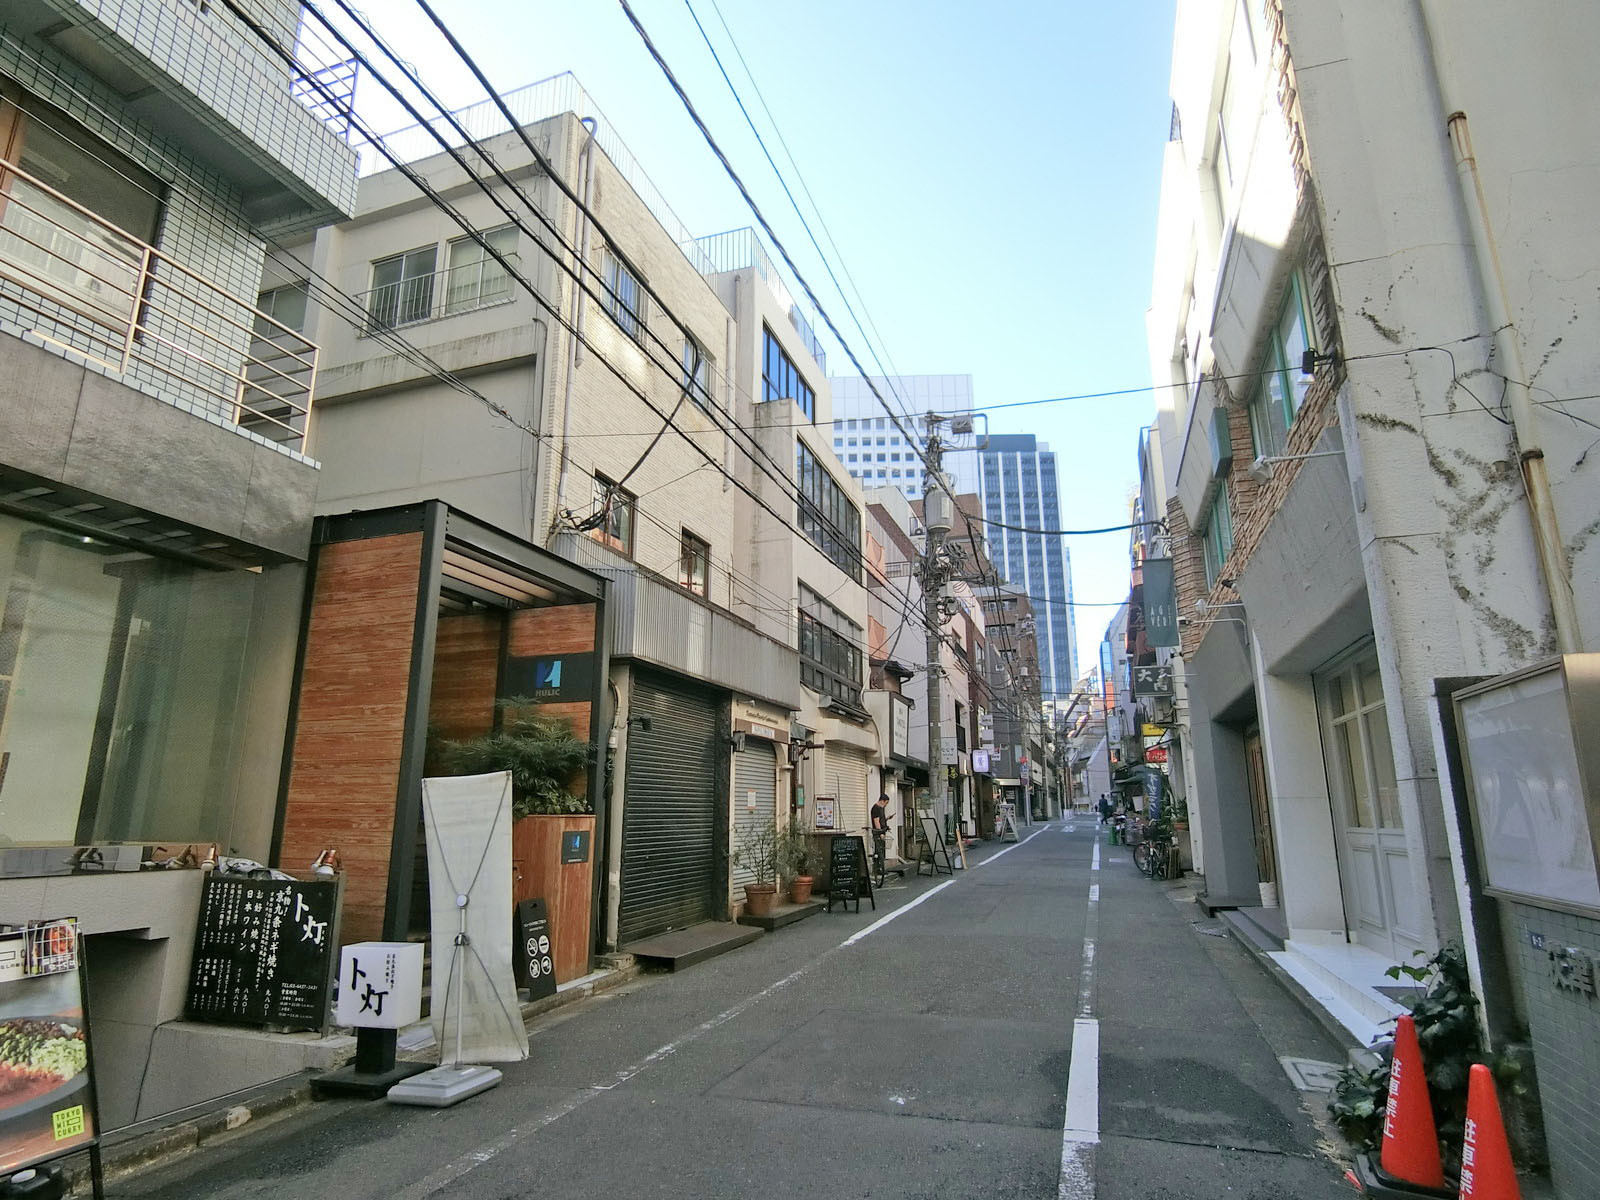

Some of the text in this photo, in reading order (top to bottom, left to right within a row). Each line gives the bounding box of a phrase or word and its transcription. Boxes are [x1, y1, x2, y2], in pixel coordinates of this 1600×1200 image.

[240, 889, 254, 951] 日本ワイン
[56, 1108, 81, 1120] TOKYO
[57, 1125, 82, 1137] CURRY
